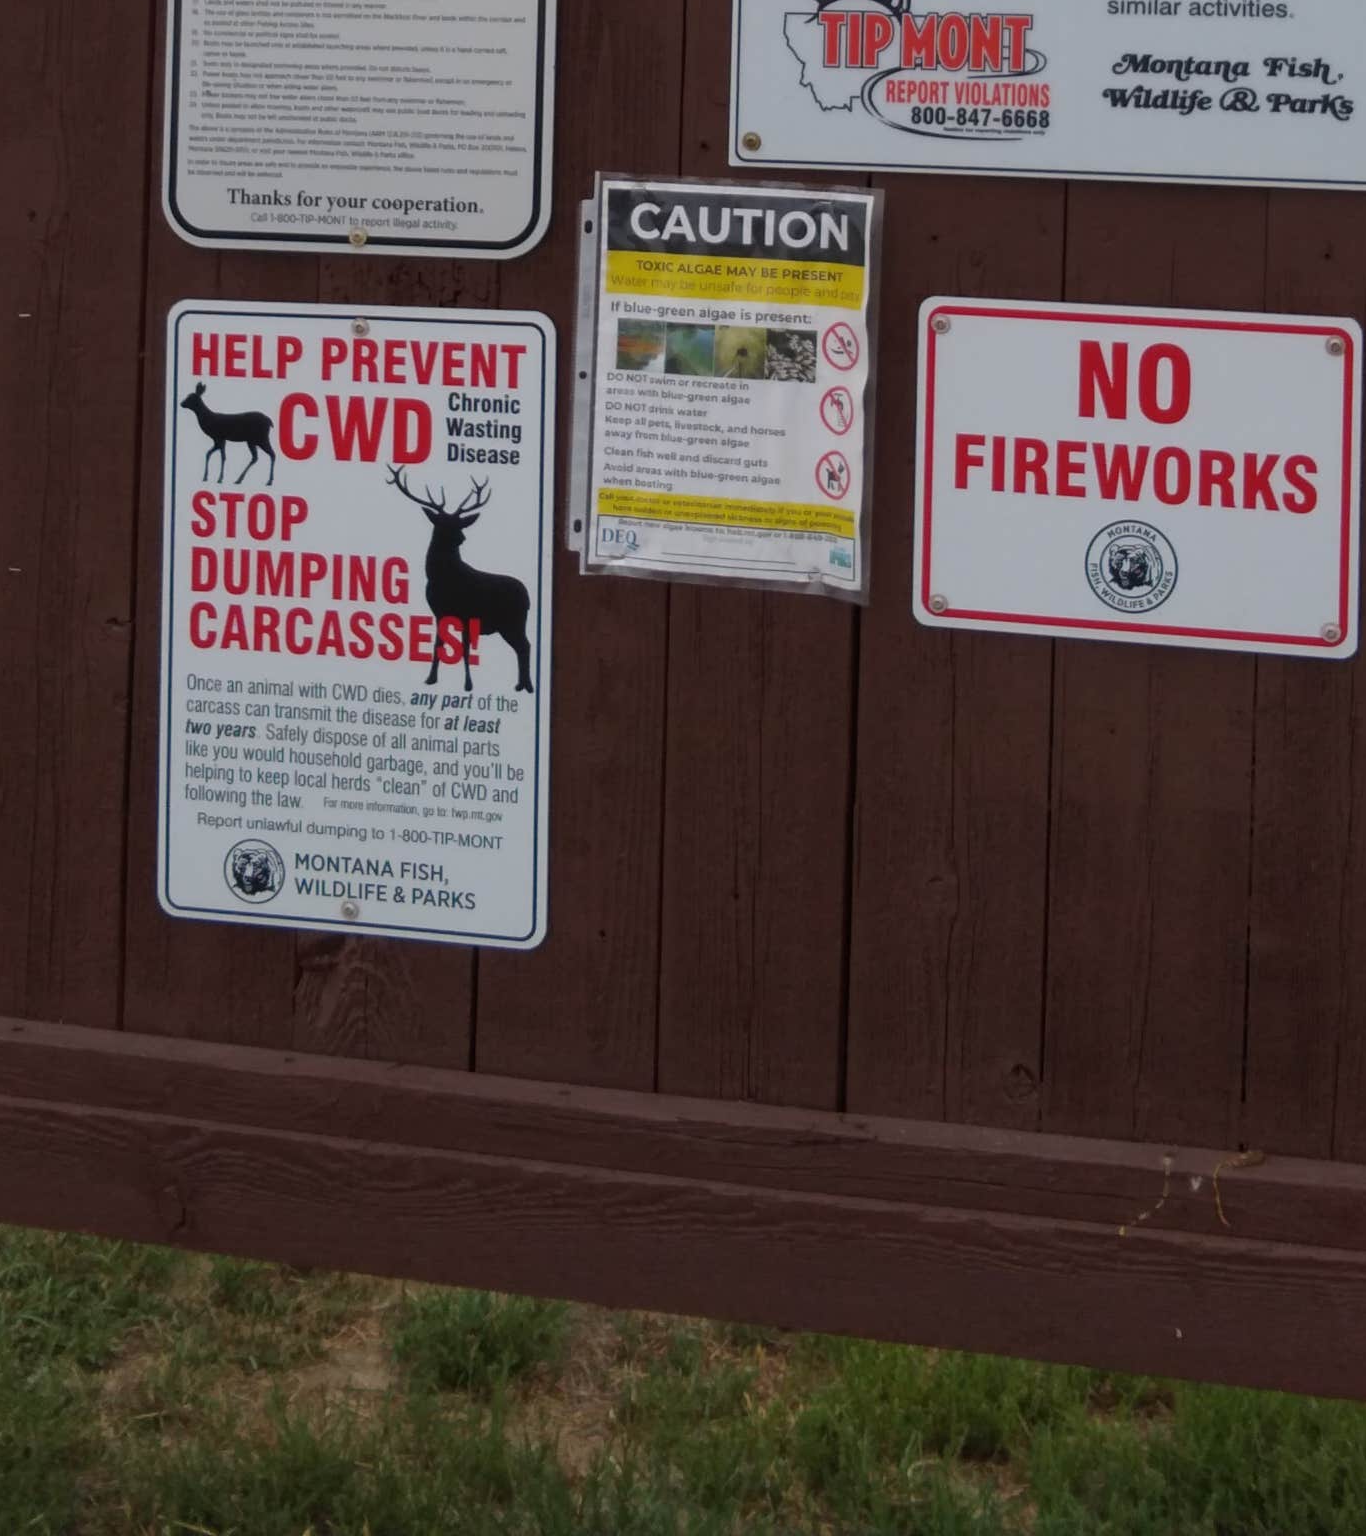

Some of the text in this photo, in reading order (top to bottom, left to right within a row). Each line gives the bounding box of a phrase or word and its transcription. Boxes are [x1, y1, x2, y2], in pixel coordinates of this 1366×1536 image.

[818, 11, 1033, 72] TIP MONT
[1112, 53, 1343, 84] Montana Fish,
[886, 80, 1049, 108] REPORT VIOLATIONS
[1102, 86, 1353, 120] Wildlife & Parks
[908, 106, 1049, 130] 800-847-6668
[227, 188, 483, 215] Thanks for your cooperation.
[251, 213, 458, 230] Call 1-800-TIP-MONT to report illegal activity.
[630, 202, 847, 250] CAUTION
[636, 260, 843, 282] TOXIC ALGAE MAY BE PRESENT
[611, 301, 812, 325] If blue-green algae is present:
[192, 332, 526, 389] HELP PREVENT
[1079, 340, 1190, 424] NO
[448, 393, 520, 414] Chronic
[279, 392, 431, 465] CWD
[446, 417, 521, 443] Wasting
[447, 443, 519, 465] Disease
[955, 433, 1317, 514] FIREWORKS
[191, 491, 308, 541] STOP
[1107, 525, 1157, 541] MONTANA
[191, 546, 408, 604] DUMPING
[1089, 562, 1173, 608] FISH, WILDLIFE & PARKS
[190, 602, 483, 665] CARCASSES!
[187, 673, 518, 712] Once an animal with CWD dies, any part of the
[197, 811, 243, 829] Report
[306, 822, 367, 842] dumping
[371, 827, 384, 840] to
[390, 828, 503, 849] 1-800-TIP-MONT
[295, 853, 448, 885] MONTANA FISH,
[294, 878, 475, 909] WILDLIFE & PARKS
